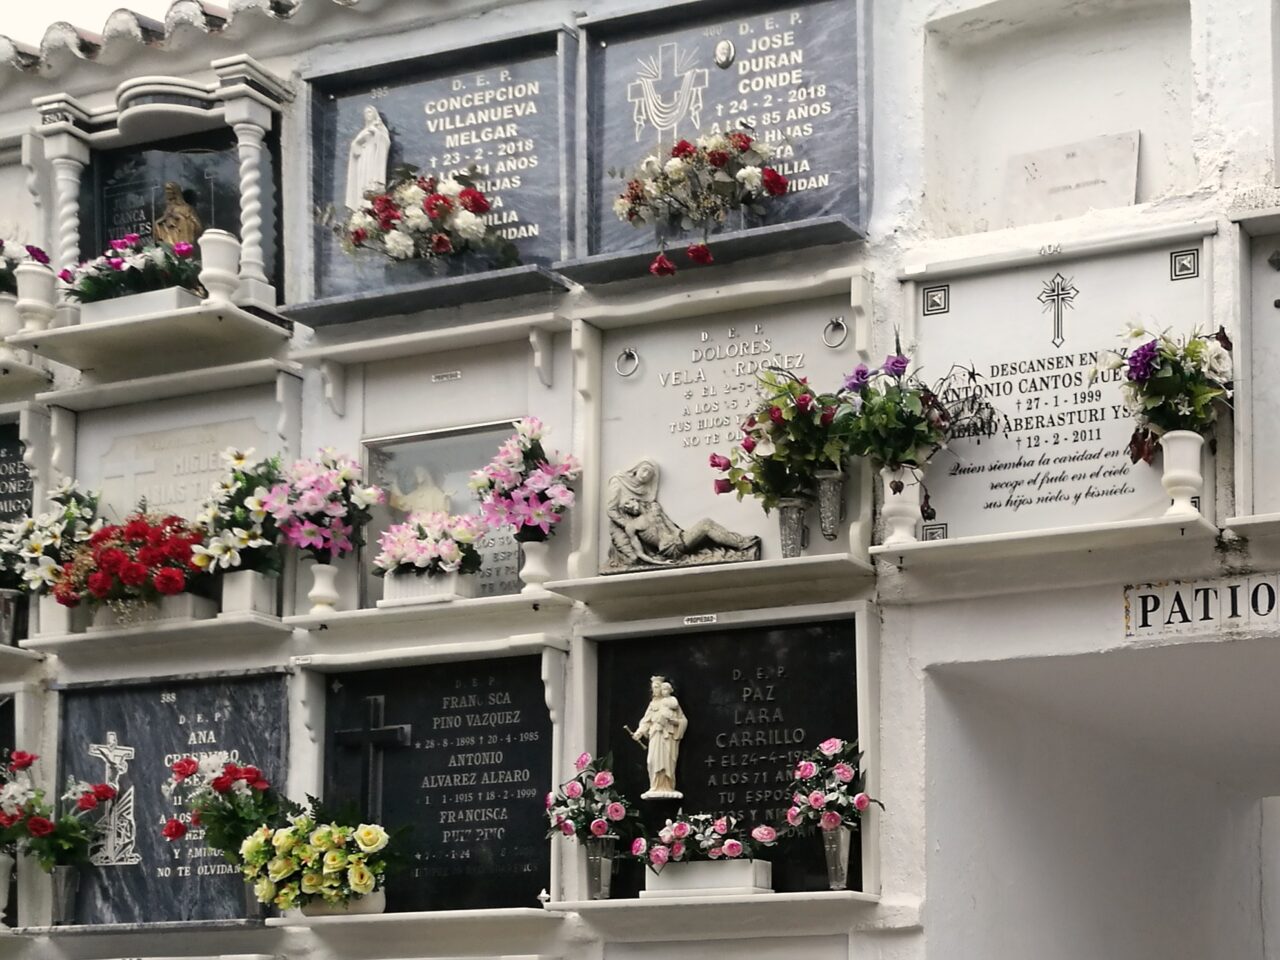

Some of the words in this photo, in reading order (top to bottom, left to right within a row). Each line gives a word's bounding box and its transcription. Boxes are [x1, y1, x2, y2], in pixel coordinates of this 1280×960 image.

[745, 31, 795, 53] JOSE
[738, 49, 803, 75] DURAN
[738, 69, 803, 94] CONDE
[424, 82, 540, 115] CONCEPCION
[788, 84, 827, 103] 2018
[426, 101, 538, 133] VILLANUEVA
[761, 111, 781, 126] 85
[786, 101, 832, 122] AÑOS
[445, 123, 518, 149] MELGAR
[497, 139, 534, 156] 2018
[495, 155, 539, 174] AÑOS
[691, 338, 773, 363] DOLORES
[989, 356, 1075, 378] DESCANSEN
[1080, 352, 1098, 368] EN
[658, 368, 707, 387] VELA
[1018, 374, 1083, 393] CANTOS
[1073, 390, 1102, 407] 1999
[1003, 407, 1106, 434] ABERASTURI
[1073, 428, 1102, 444] 2011
[987, 456, 1035, 473] siembra
[1053, 451, 1102, 466] caridad
[990, 477, 1025, 493] recoge
[1040, 471, 1069, 491] fruto
[1102, 465, 1129, 479] cielo
[1005, 494, 1033, 512] hijos
[1036, 491, 1070, 504] nietos
[1138, 582, 1276, 628] PATIO
[743, 685, 776, 701] PAZ
[432, 715, 462, 730] PINO
[466, 710, 521, 727] VAZQUEZ
[734, 707, 784, 725] LARA
[188, 730, 217, 744] ANA
[716, 728, 805, 748] CARRILLO
[448, 751, 504, 767] ANTONIO
[421, 773, 477, 789] ALVAREZ
[481, 769, 530, 784] ALFARO
[722, 773, 749, 785] LOS
[439, 808, 508, 824] FRANCISCA
[157, 867, 171, 877] NO
[178, 866, 191, 876] TE
[197, 863, 241, 875] OLVIDAN
